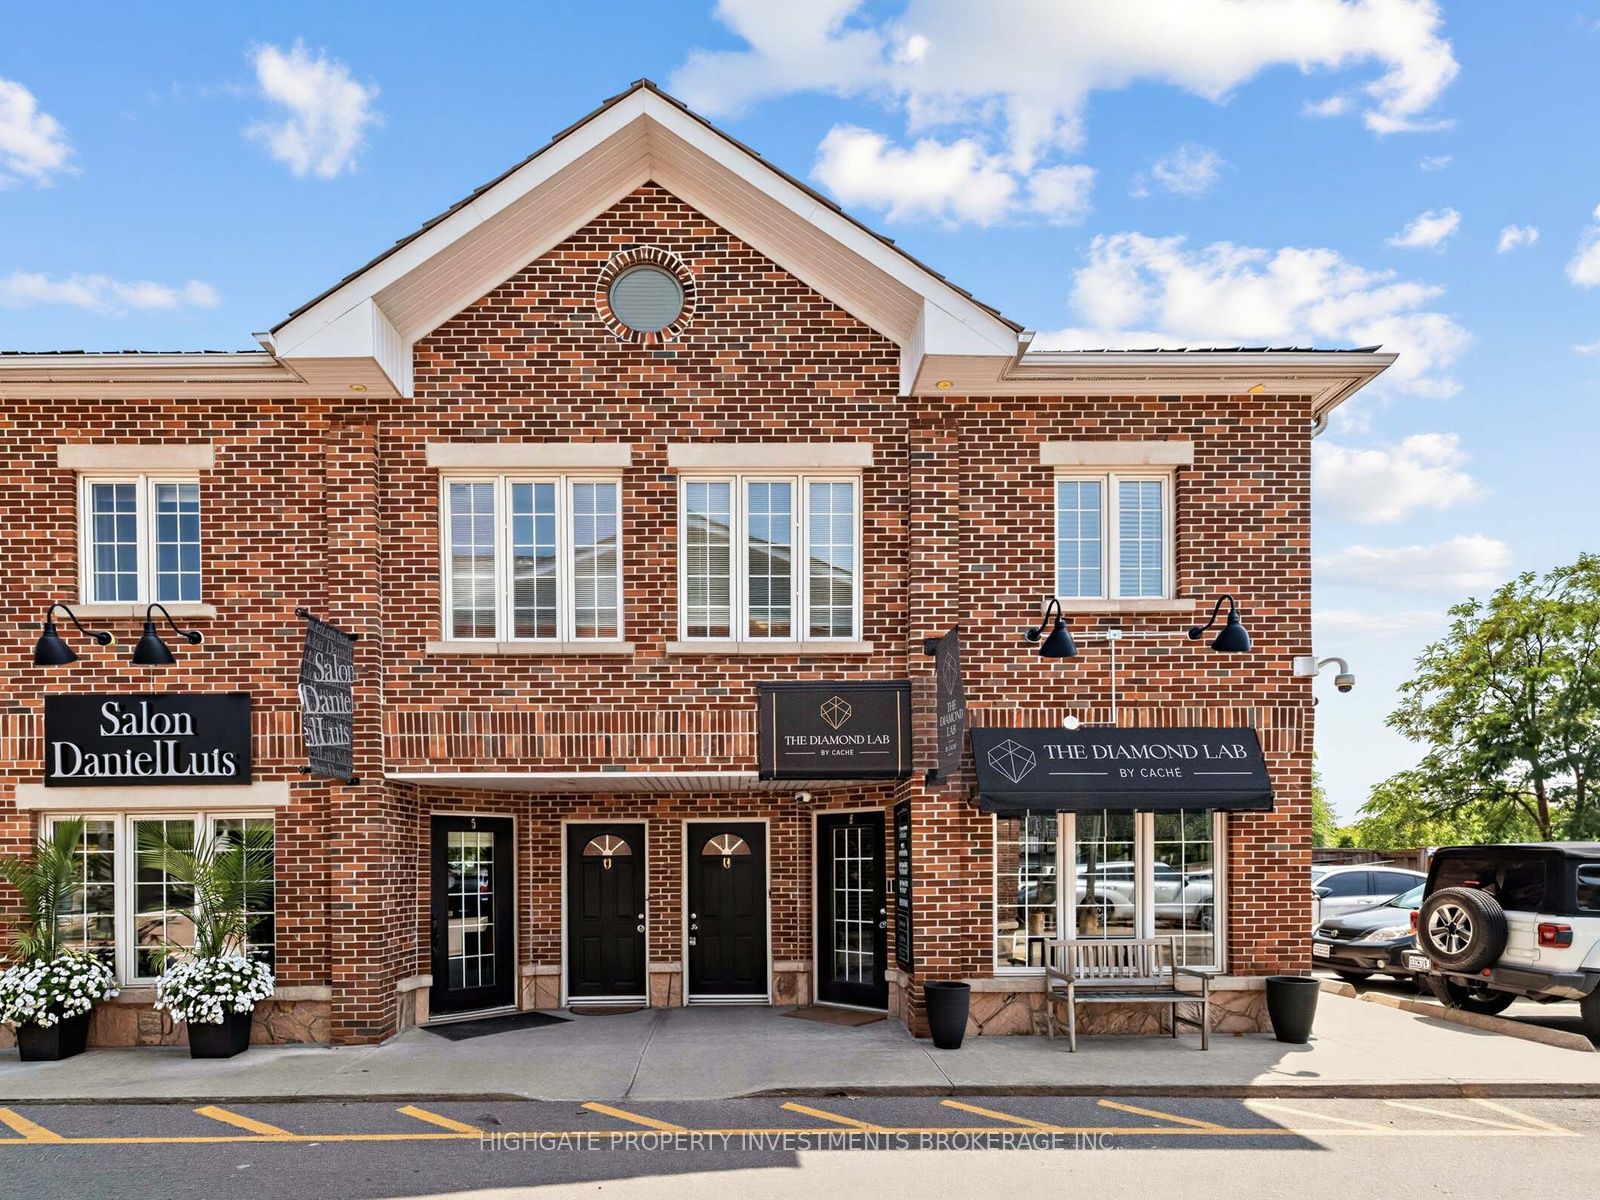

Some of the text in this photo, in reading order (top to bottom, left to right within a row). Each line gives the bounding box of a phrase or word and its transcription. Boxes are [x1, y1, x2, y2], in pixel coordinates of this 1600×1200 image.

[314, 652, 354, 683] Salon
[946, 699, 957, 713] THE
[100, 700, 195, 737] Salon
[939, 708, 964, 727] DIAMOND
[946, 724, 957, 737] LAB
[784, 734, 890, 746] THE DIAMOND LAB
[50, 739, 237, 778] DanielLuis
[1043, 744, 1248, 760] THE DIAMOND LAB
[1119, 767, 1135, 778] BY
